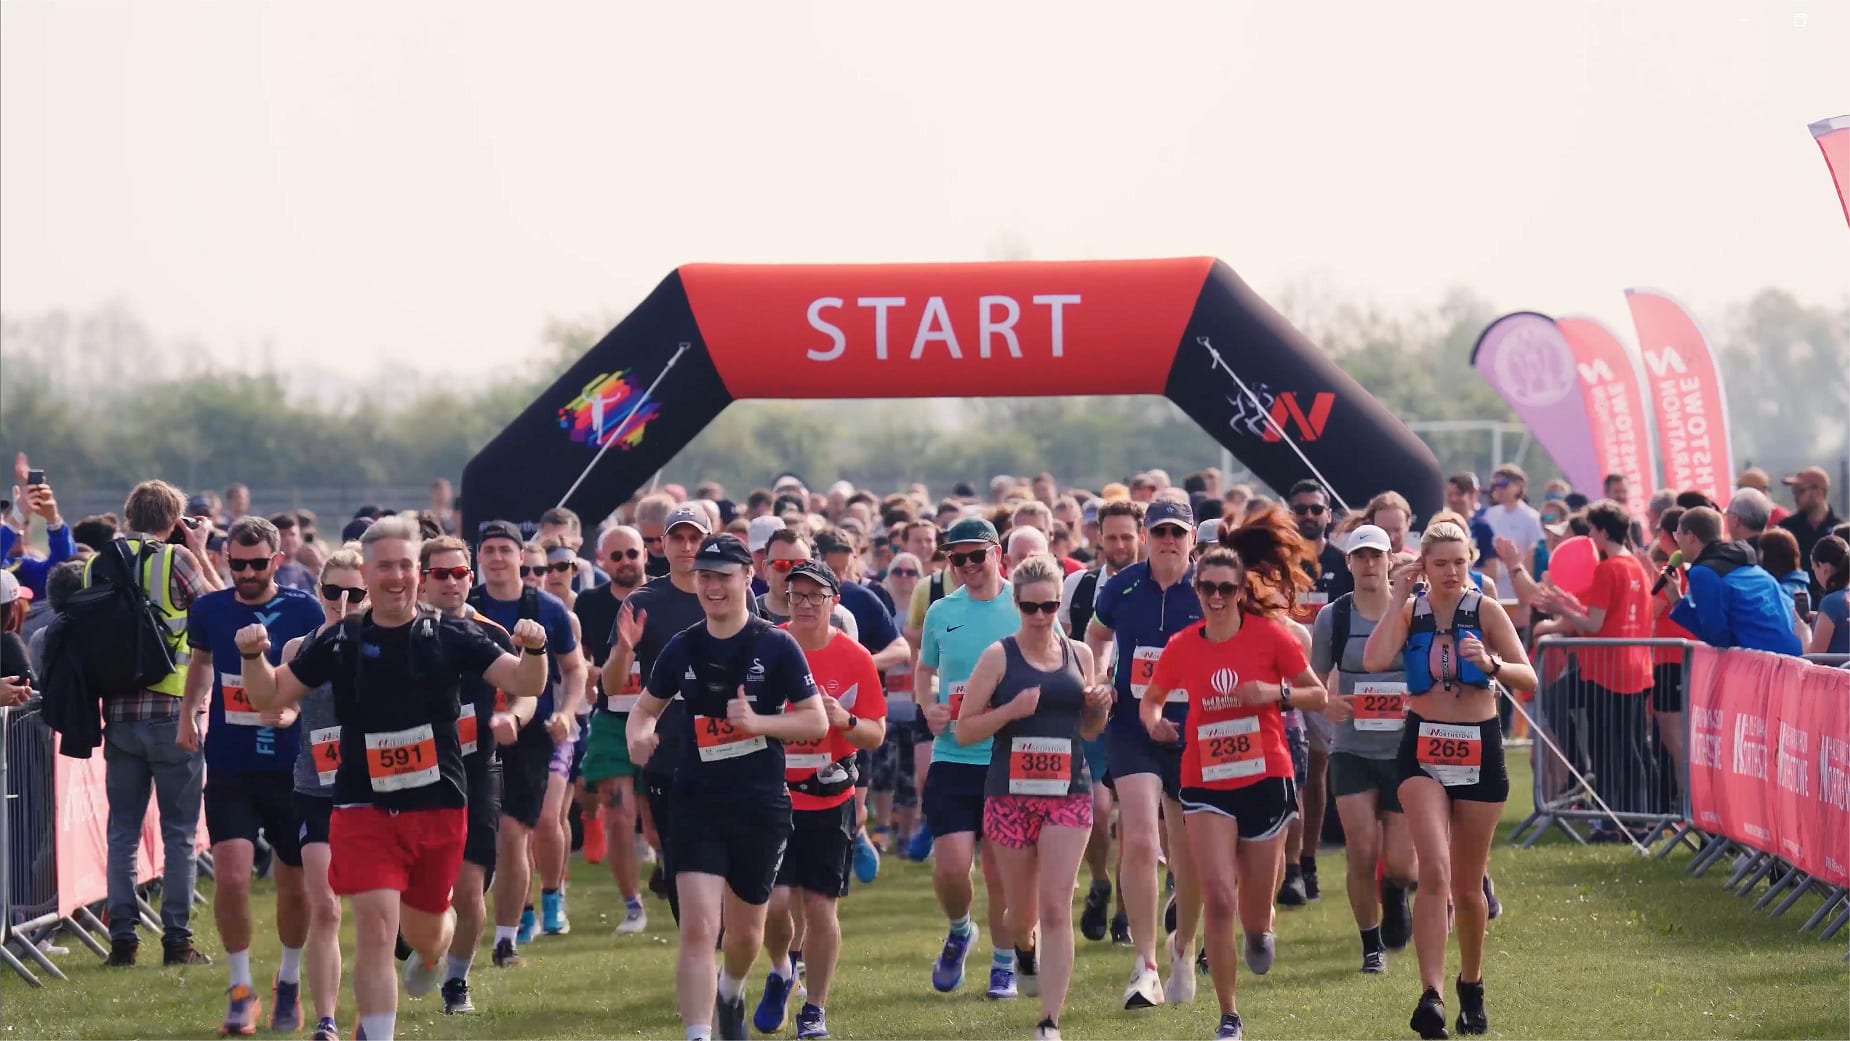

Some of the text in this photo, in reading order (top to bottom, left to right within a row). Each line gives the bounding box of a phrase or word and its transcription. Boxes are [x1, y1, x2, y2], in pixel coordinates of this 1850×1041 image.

[806, 294, 1082, 361] START
[1364, 695, 1403, 711] 222
[706, 717, 735, 736] 43
[1209, 736, 1251, 757] 238
[1428, 739, 1470, 758] 265
[380, 745, 422, 768] 591
[1021, 753, 1062, 771] 388
